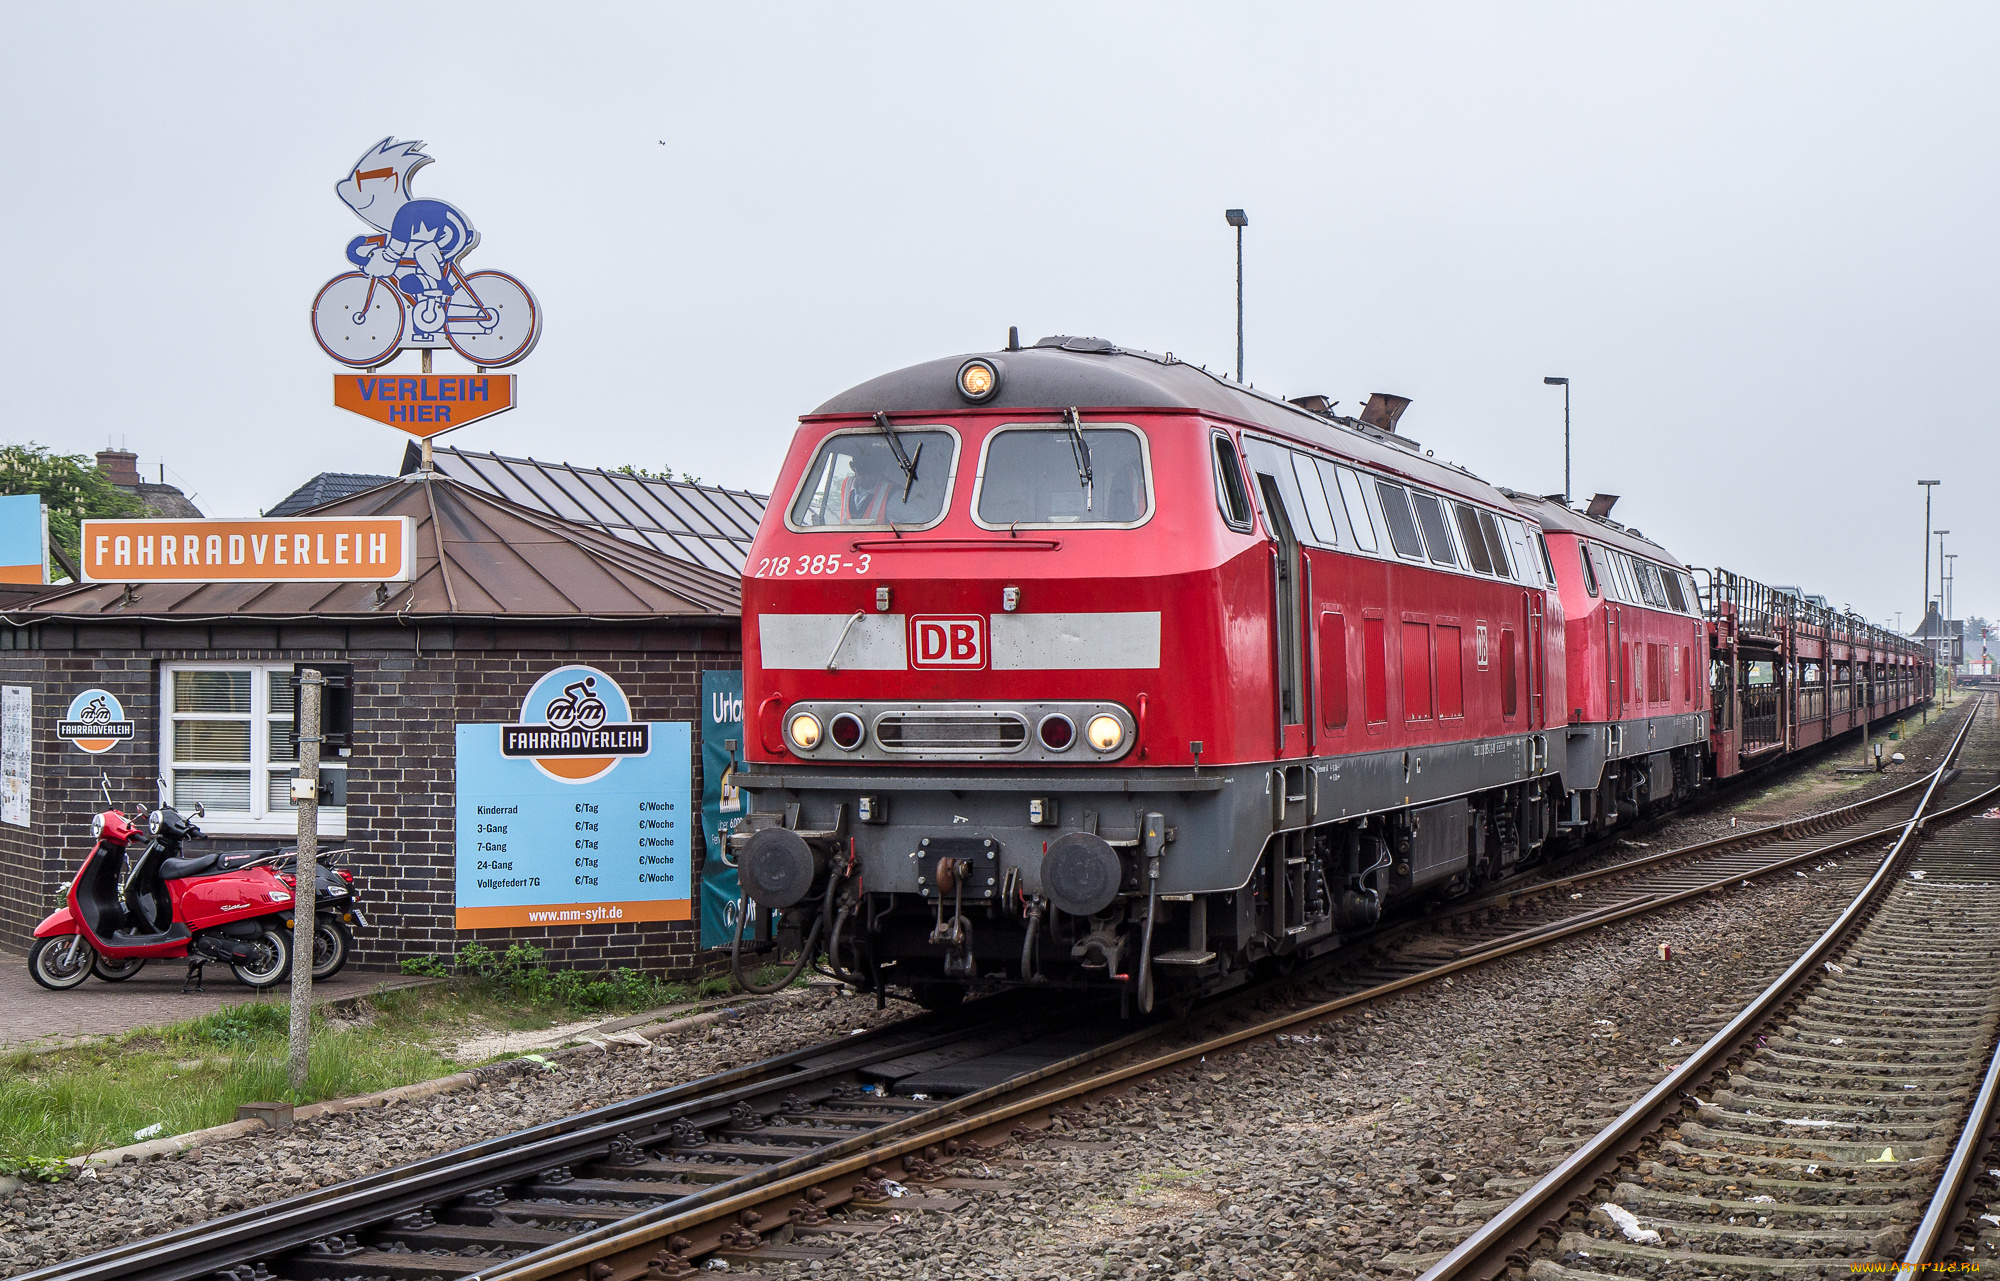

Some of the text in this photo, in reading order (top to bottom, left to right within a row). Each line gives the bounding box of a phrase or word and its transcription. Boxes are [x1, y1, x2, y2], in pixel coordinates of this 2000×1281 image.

[356, 378, 489, 402] VERLEIH
[388, 405, 452, 423] HIER
[95, 533, 387, 566] FAHRRADVERLEIH
[754, 553, 872, 579] 218 385-3
[920, 623, 977, 660] DB
[1477, 628, 1487, 662] DB
[712, 691, 743, 724] Urla
[61, 725, 131, 735] FAHRRADVERLEIH
[509, 731, 643, 750] FAHRRADVERLEIH
[1265, 771, 1270, 795] 2
[477, 802, 675, 815] Kinderrad €/Tag €/Woche
[477, 819, 675, 835] 3-Gang €/Tag €/Woche
[477, 837, 675, 853] 7-Gang €/Tag €/Woche
[477, 855, 675, 871] 24-Gang €/Tag €/Woche
[477, 873, 675, 890] Vollgefedert 7G €/Tag €/Woche
[529, 906, 623, 922] www.mm-sylt.de
